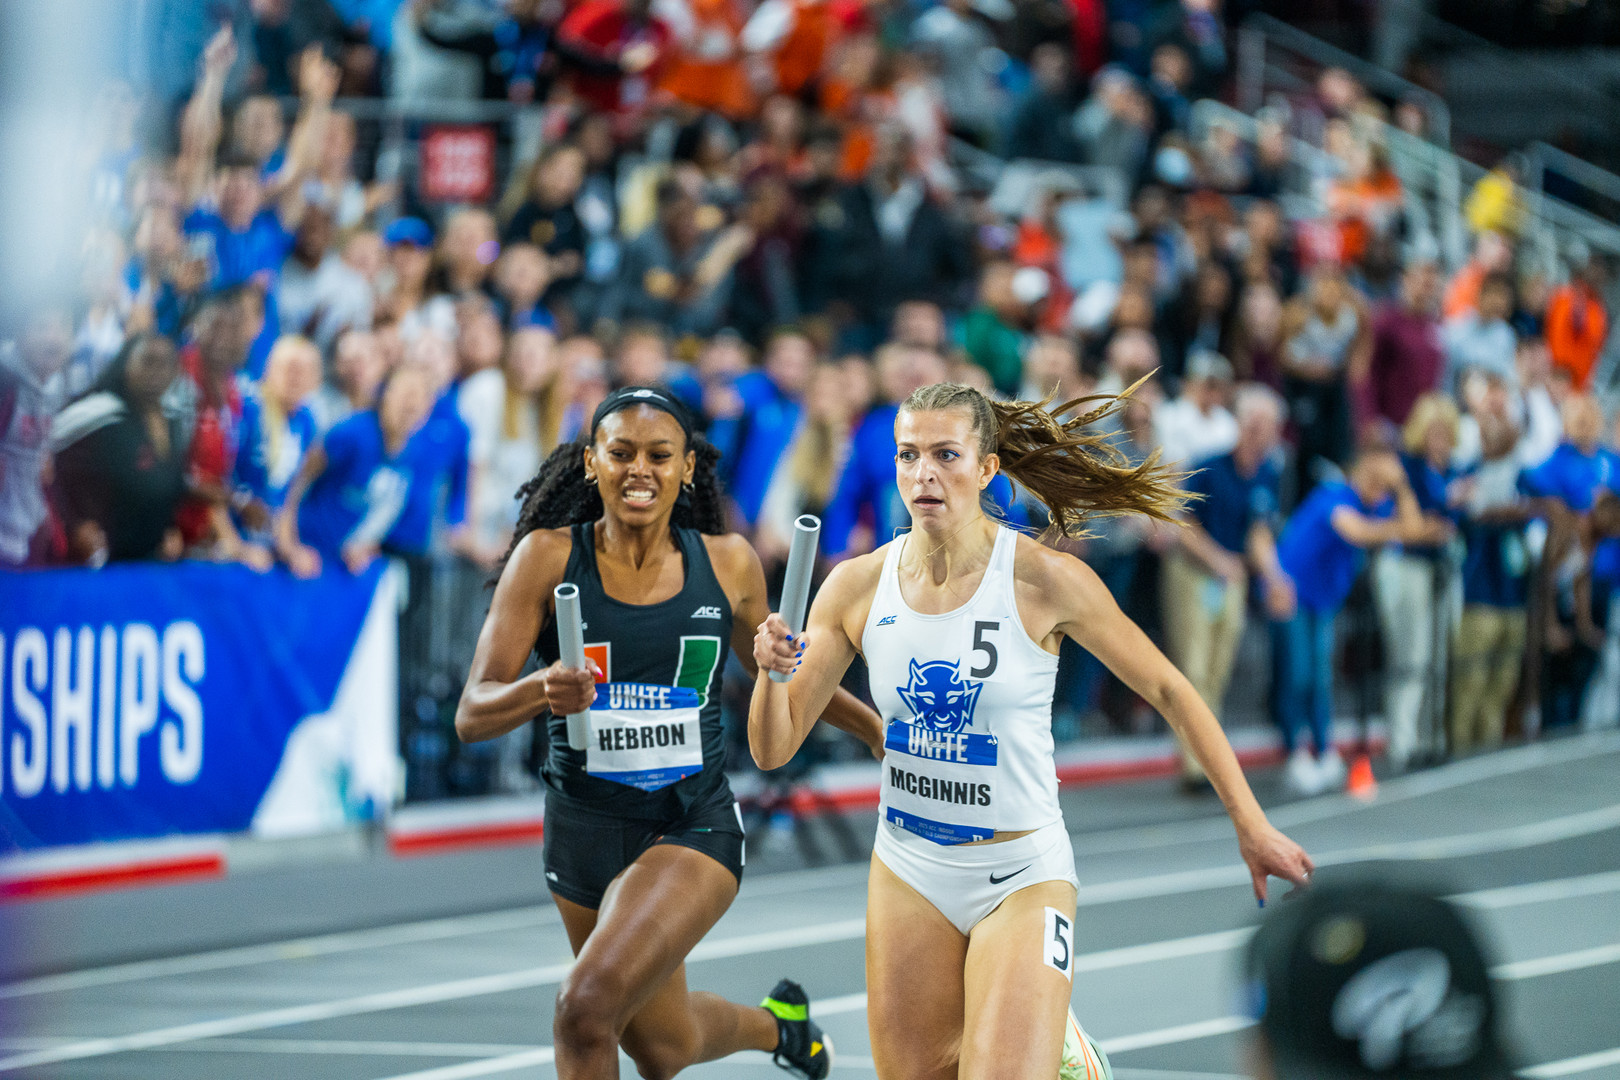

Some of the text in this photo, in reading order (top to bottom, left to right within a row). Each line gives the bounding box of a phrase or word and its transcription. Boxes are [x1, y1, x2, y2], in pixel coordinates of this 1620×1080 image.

[691, 605, 721, 619] ACC
[877, 615, 897, 626] ACC
[970, 620, 1000, 679] 5
[0, 617, 206, 798] SHIPS
[609, 683, 672, 710] UNITE
[598, 723, 686, 752] HEBRON
[907, 725, 969, 763] UNITE
[890, 765, 991, 807] MCGINNIS
[1052, 913, 1069, 971] 5
